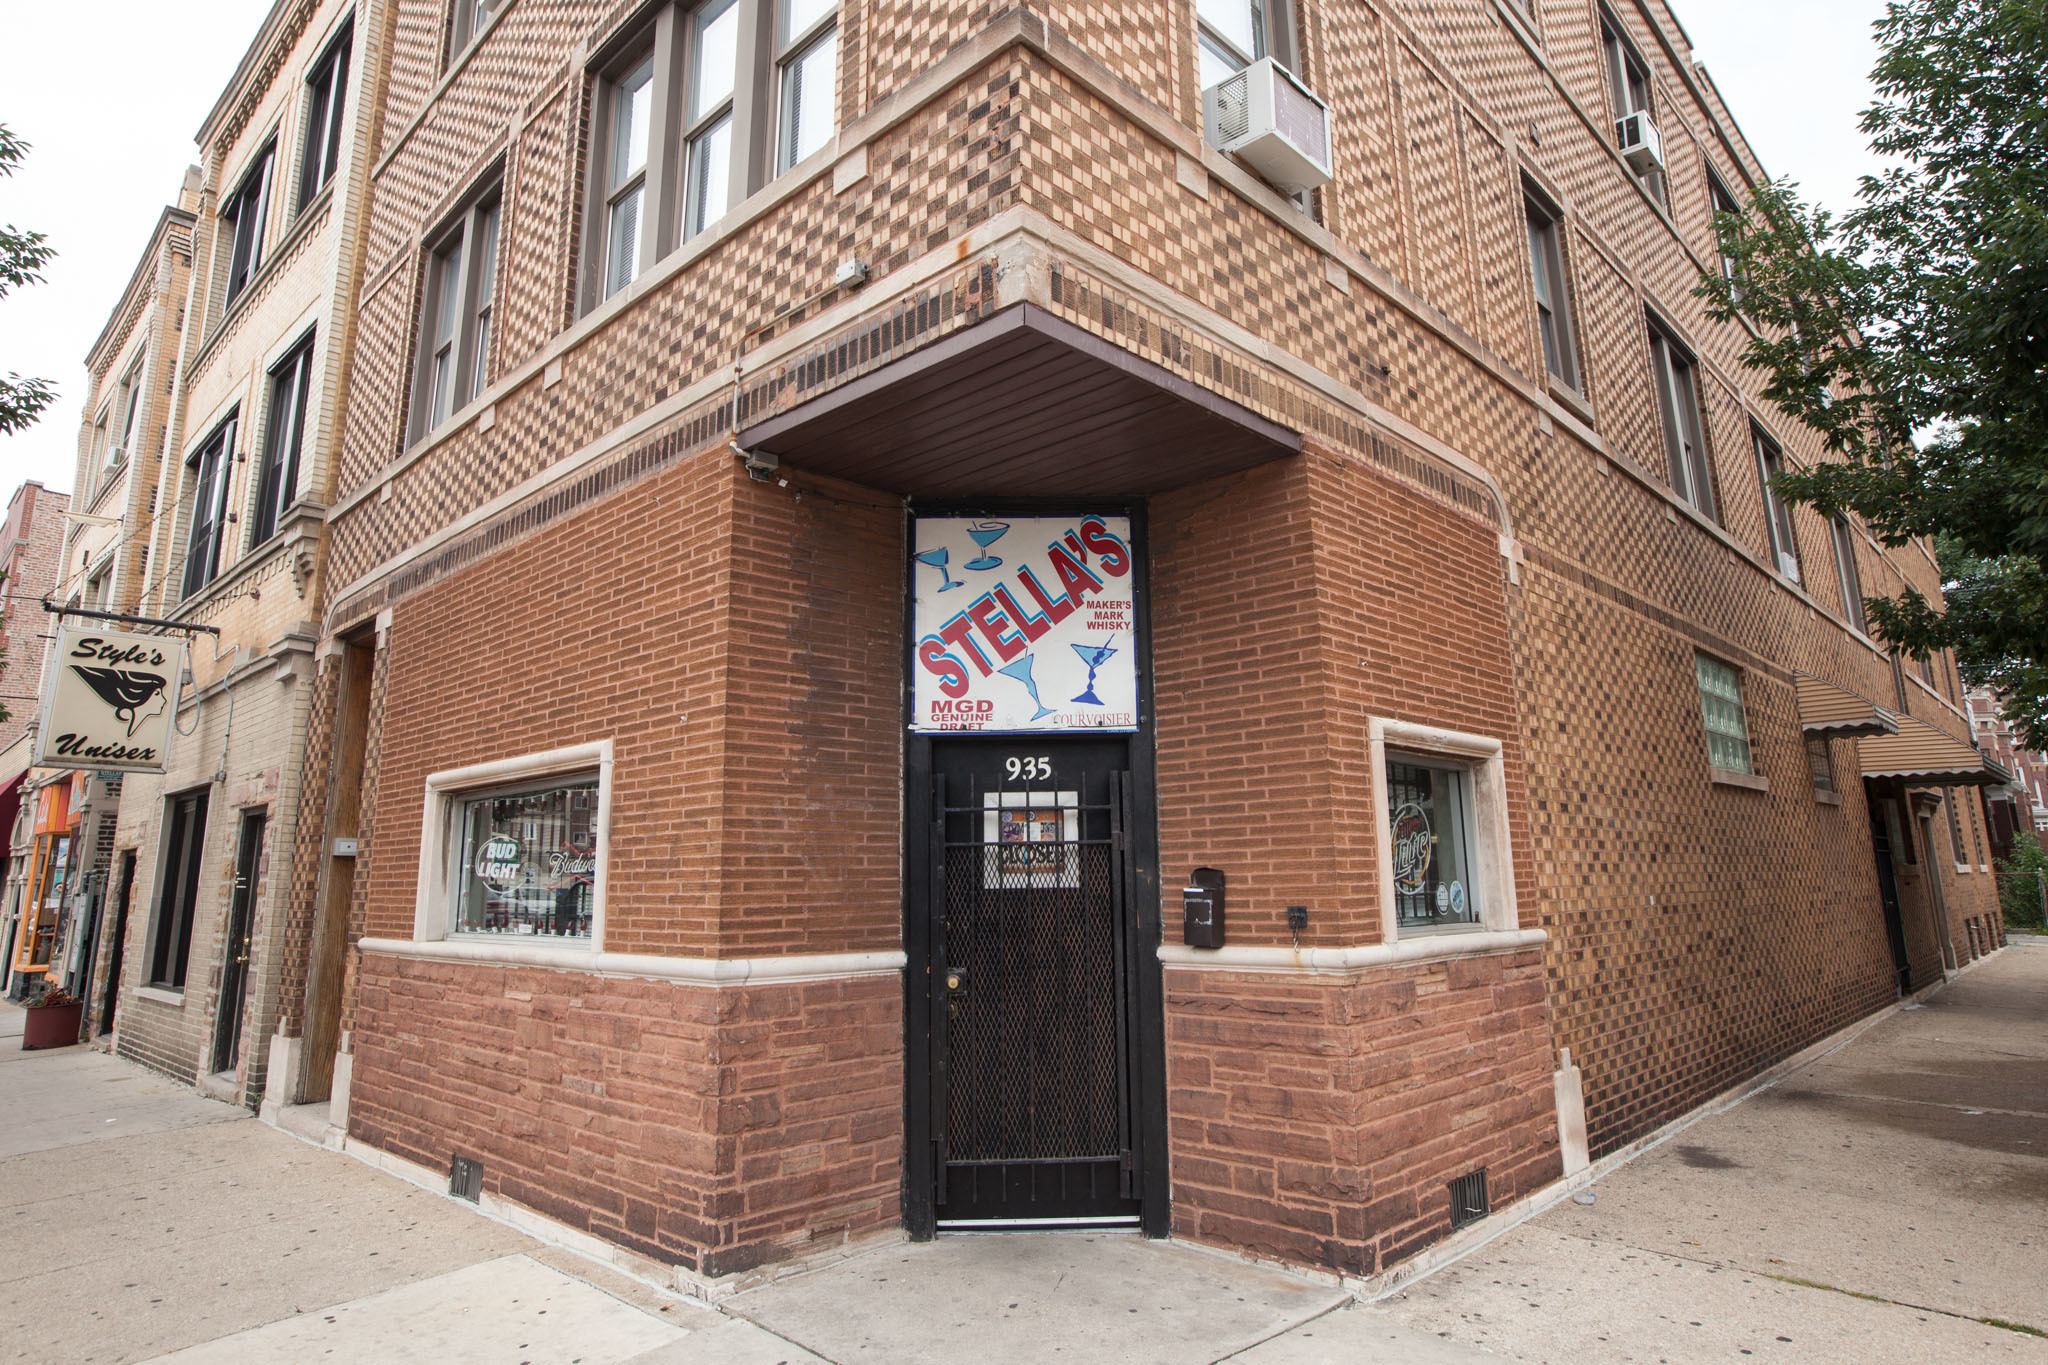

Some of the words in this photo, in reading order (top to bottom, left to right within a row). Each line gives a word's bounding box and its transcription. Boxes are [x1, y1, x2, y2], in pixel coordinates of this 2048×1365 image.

[919, 515, 1131, 699] STELLA'S
[1086, 600, 1132, 610] MAKER'S
[1094, 611, 1124, 620] MARK
[1086, 621, 1132, 631] WHISKY
[70, 637, 166, 667] Style's
[931, 700, 994, 714] MGD
[931, 713, 993, 722] GENUINE
[1053, 712, 1132, 727] COURVOISIER
[940, 722, 985, 731] DRAFT
[55, 733, 157, 761] Unisex
[1005, 756, 1052, 781] 935
[486, 842, 517, 859] BUD
[1394, 831, 1428, 880] Lite
[477, 862, 521, 880] LIGHT
